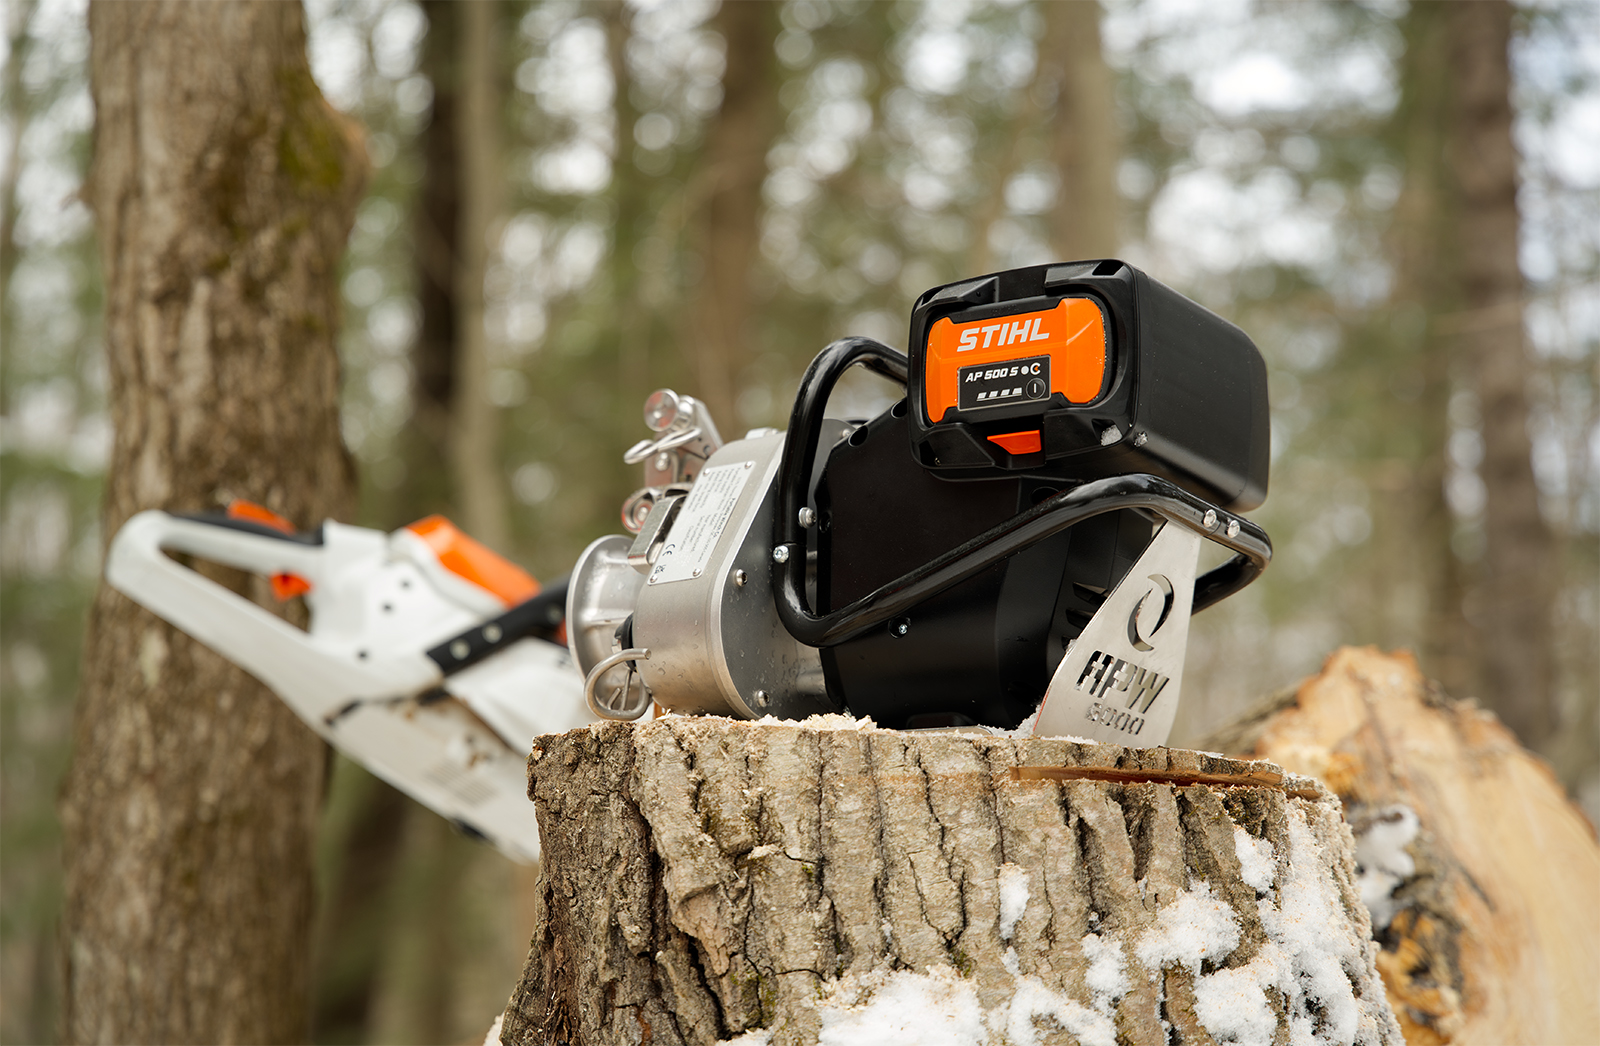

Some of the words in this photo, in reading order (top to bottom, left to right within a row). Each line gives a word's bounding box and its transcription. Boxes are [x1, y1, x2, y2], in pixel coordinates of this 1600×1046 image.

[957, 318, 1050, 352] STIHL
[965, 371, 983, 383] AP
[984, 368, 1008, 380] 500
[1009, 366, 1019, 377] S
